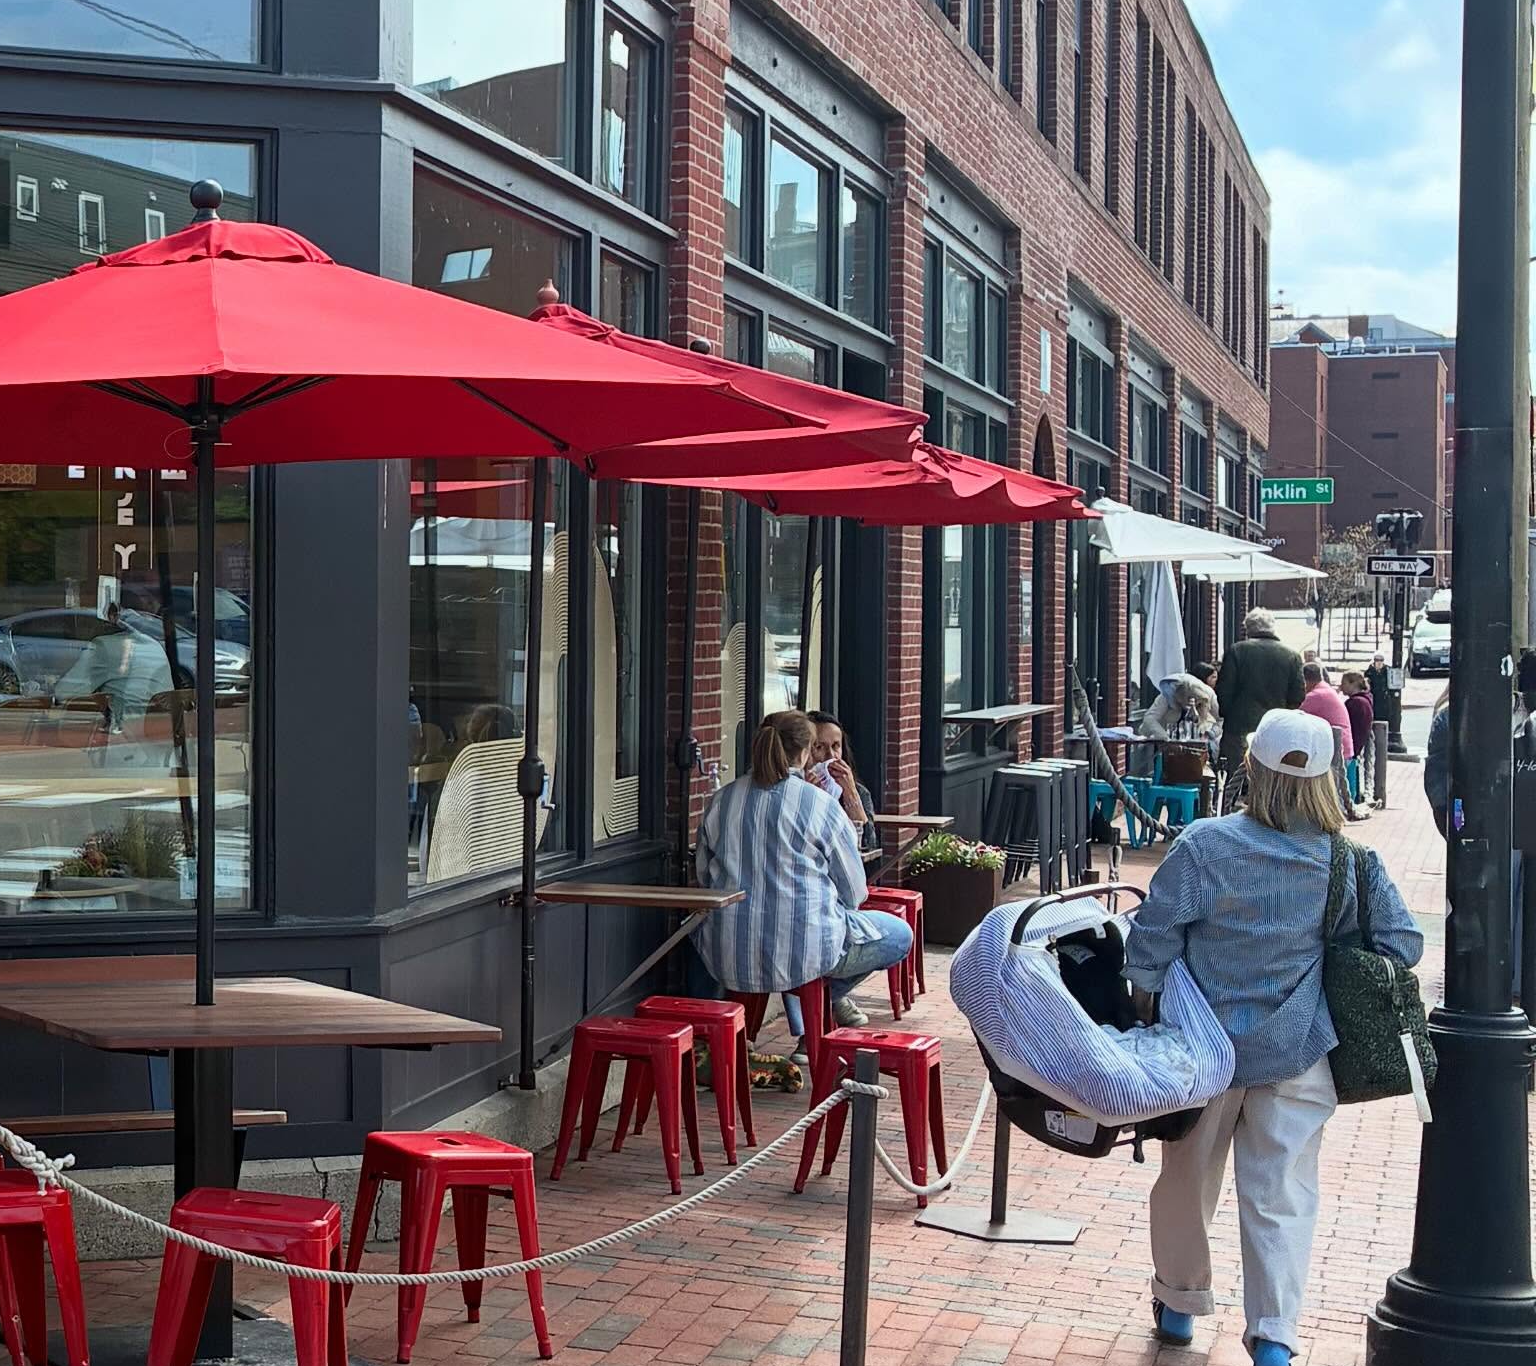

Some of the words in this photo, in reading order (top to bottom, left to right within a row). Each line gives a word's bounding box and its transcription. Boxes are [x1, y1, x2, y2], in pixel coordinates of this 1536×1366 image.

[1262, 483, 1307, 500] nklin
[1315, 483, 1329, 494] St
[1374, 562, 1394, 571] ONE
[1399, 562, 1419, 571] WAY
